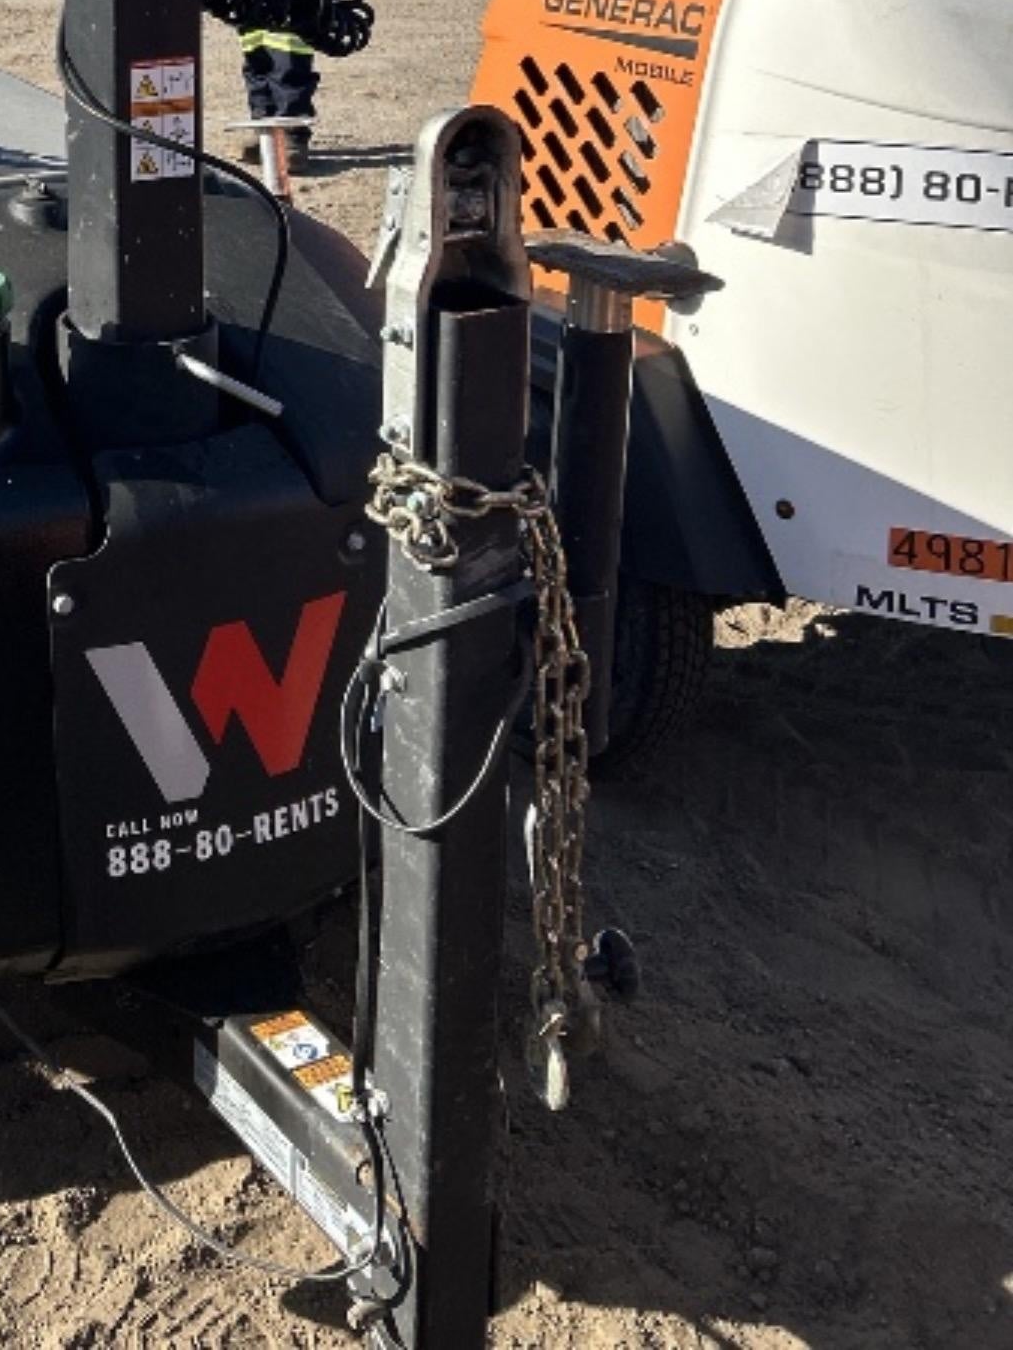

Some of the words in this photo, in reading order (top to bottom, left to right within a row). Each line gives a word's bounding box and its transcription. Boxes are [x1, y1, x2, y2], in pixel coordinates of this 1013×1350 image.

[614, 56, 695, 87] MOBILE
[892, 530, 1010, 582] 4981
[855, 585, 978, 625] MLTS
[106, 818, 151, 838] CALL
[160, 809, 199, 830] NOW
[107, 787, 339, 877] 888-80-RENTS
